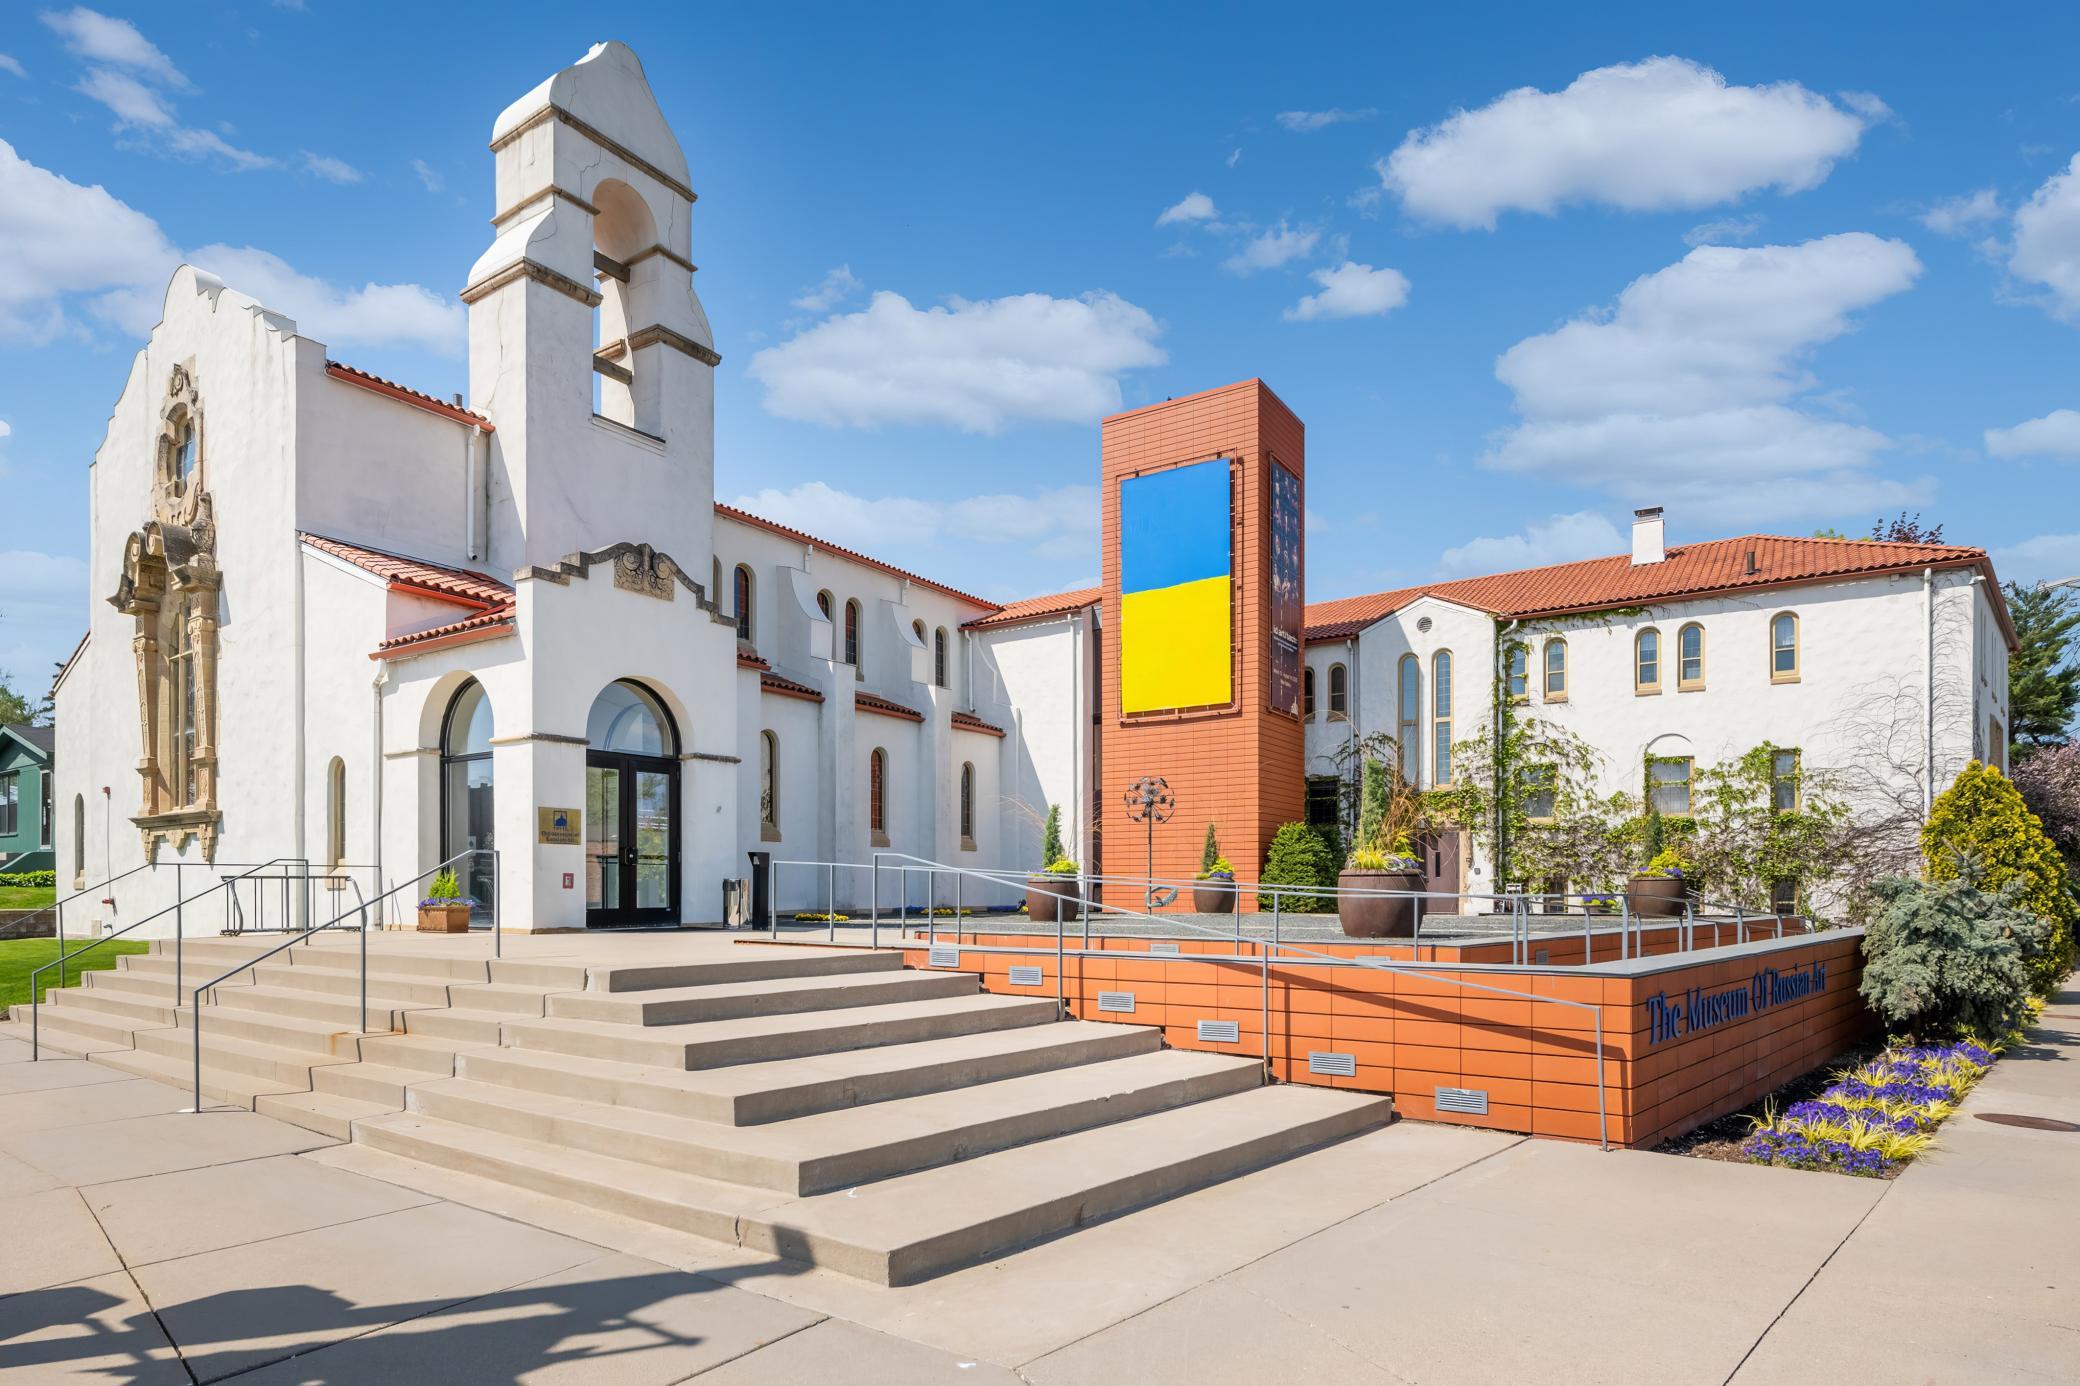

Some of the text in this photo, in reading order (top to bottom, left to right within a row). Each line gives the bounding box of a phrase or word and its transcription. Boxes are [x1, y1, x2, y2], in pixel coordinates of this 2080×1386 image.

[1645, 960, 1826, 1045] The Museum Of Russian Art
